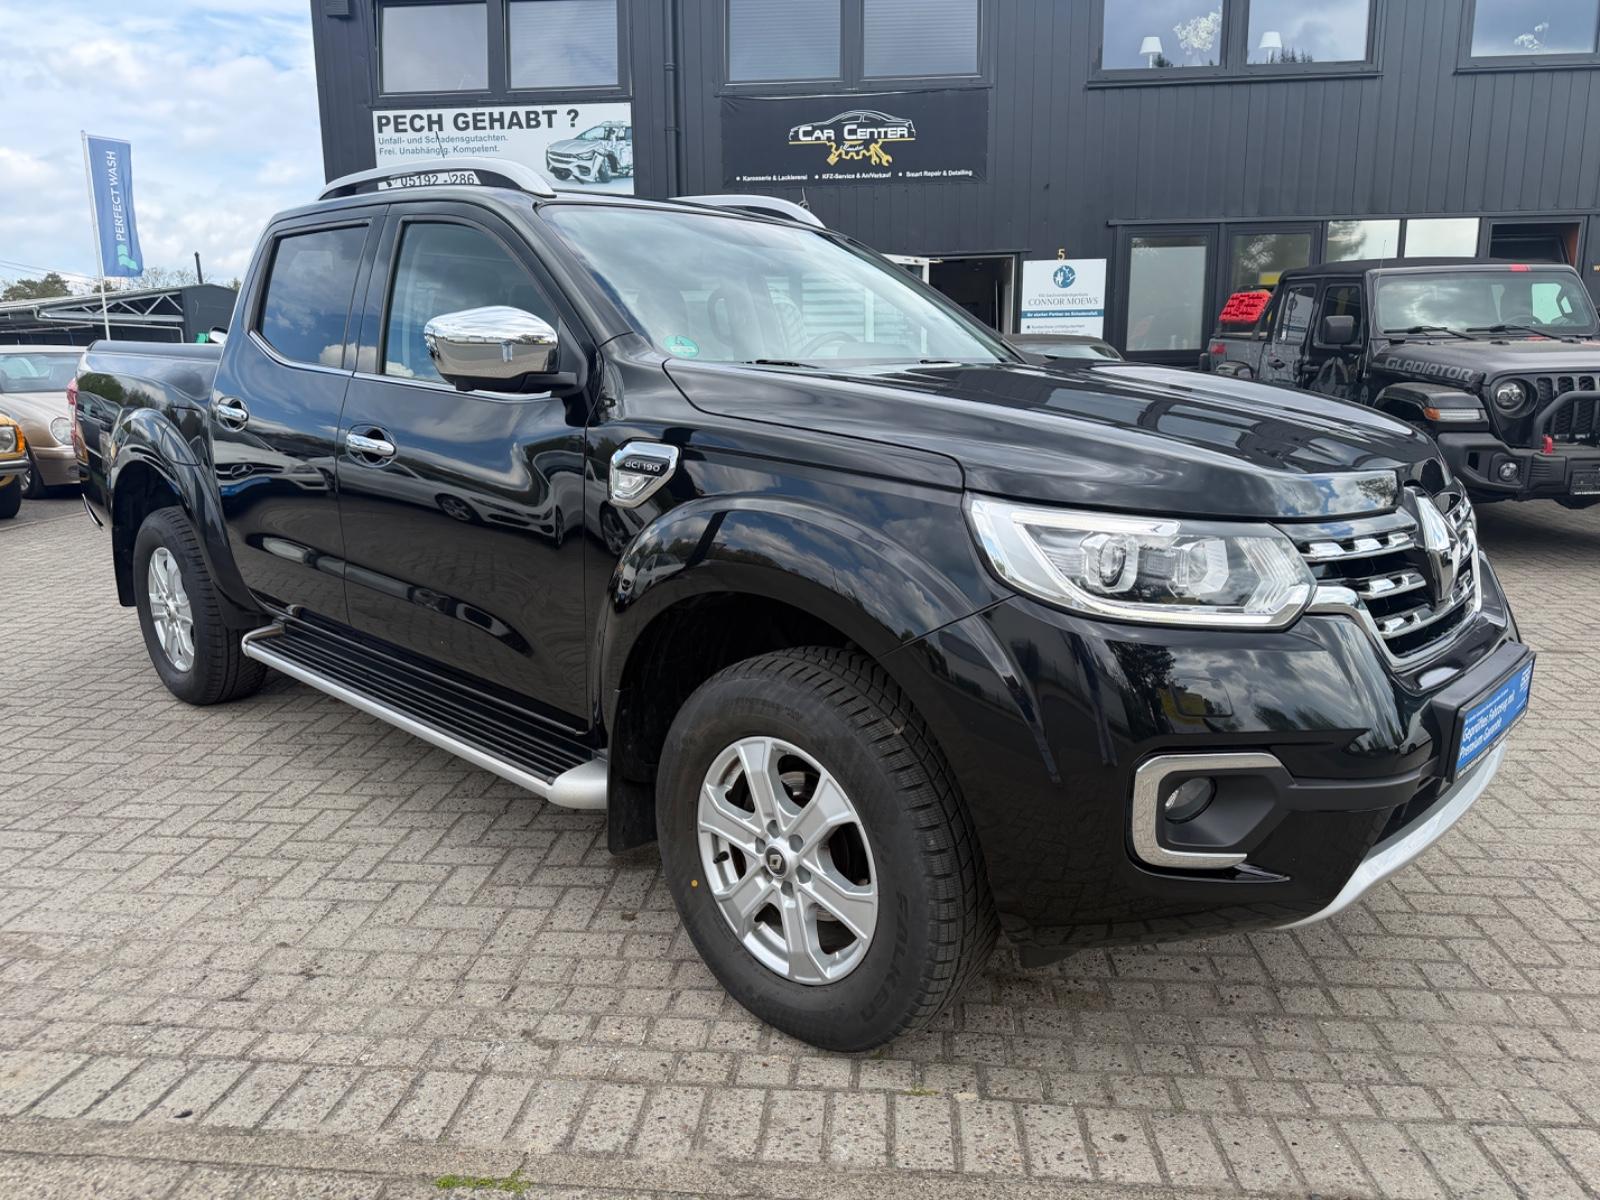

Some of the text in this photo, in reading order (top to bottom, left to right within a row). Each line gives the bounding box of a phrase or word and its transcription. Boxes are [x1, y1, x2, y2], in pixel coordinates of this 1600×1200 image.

[376, 109, 580, 134] PECH GEHABT ?
[798, 124, 908, 141] CAR CENTER
[378, 134, 508, 146] Unfall- und Schadensgutachten.
[379, 147, 397, 156] Frei.
[453, 144, 500, 155] Kompetent.
[400, 174, 439, 188] 05192
[451, 172, 475, 185] 286
[106, 150, 127, 241] PERFECT WASH
[1057, 248, 1065, 261] 5
[1028, 296, 1098, 306] CONNOR MOEWS
[1384, 357, 1474, 382] GLADIATOR
[643, 463, 660, 472] 190
